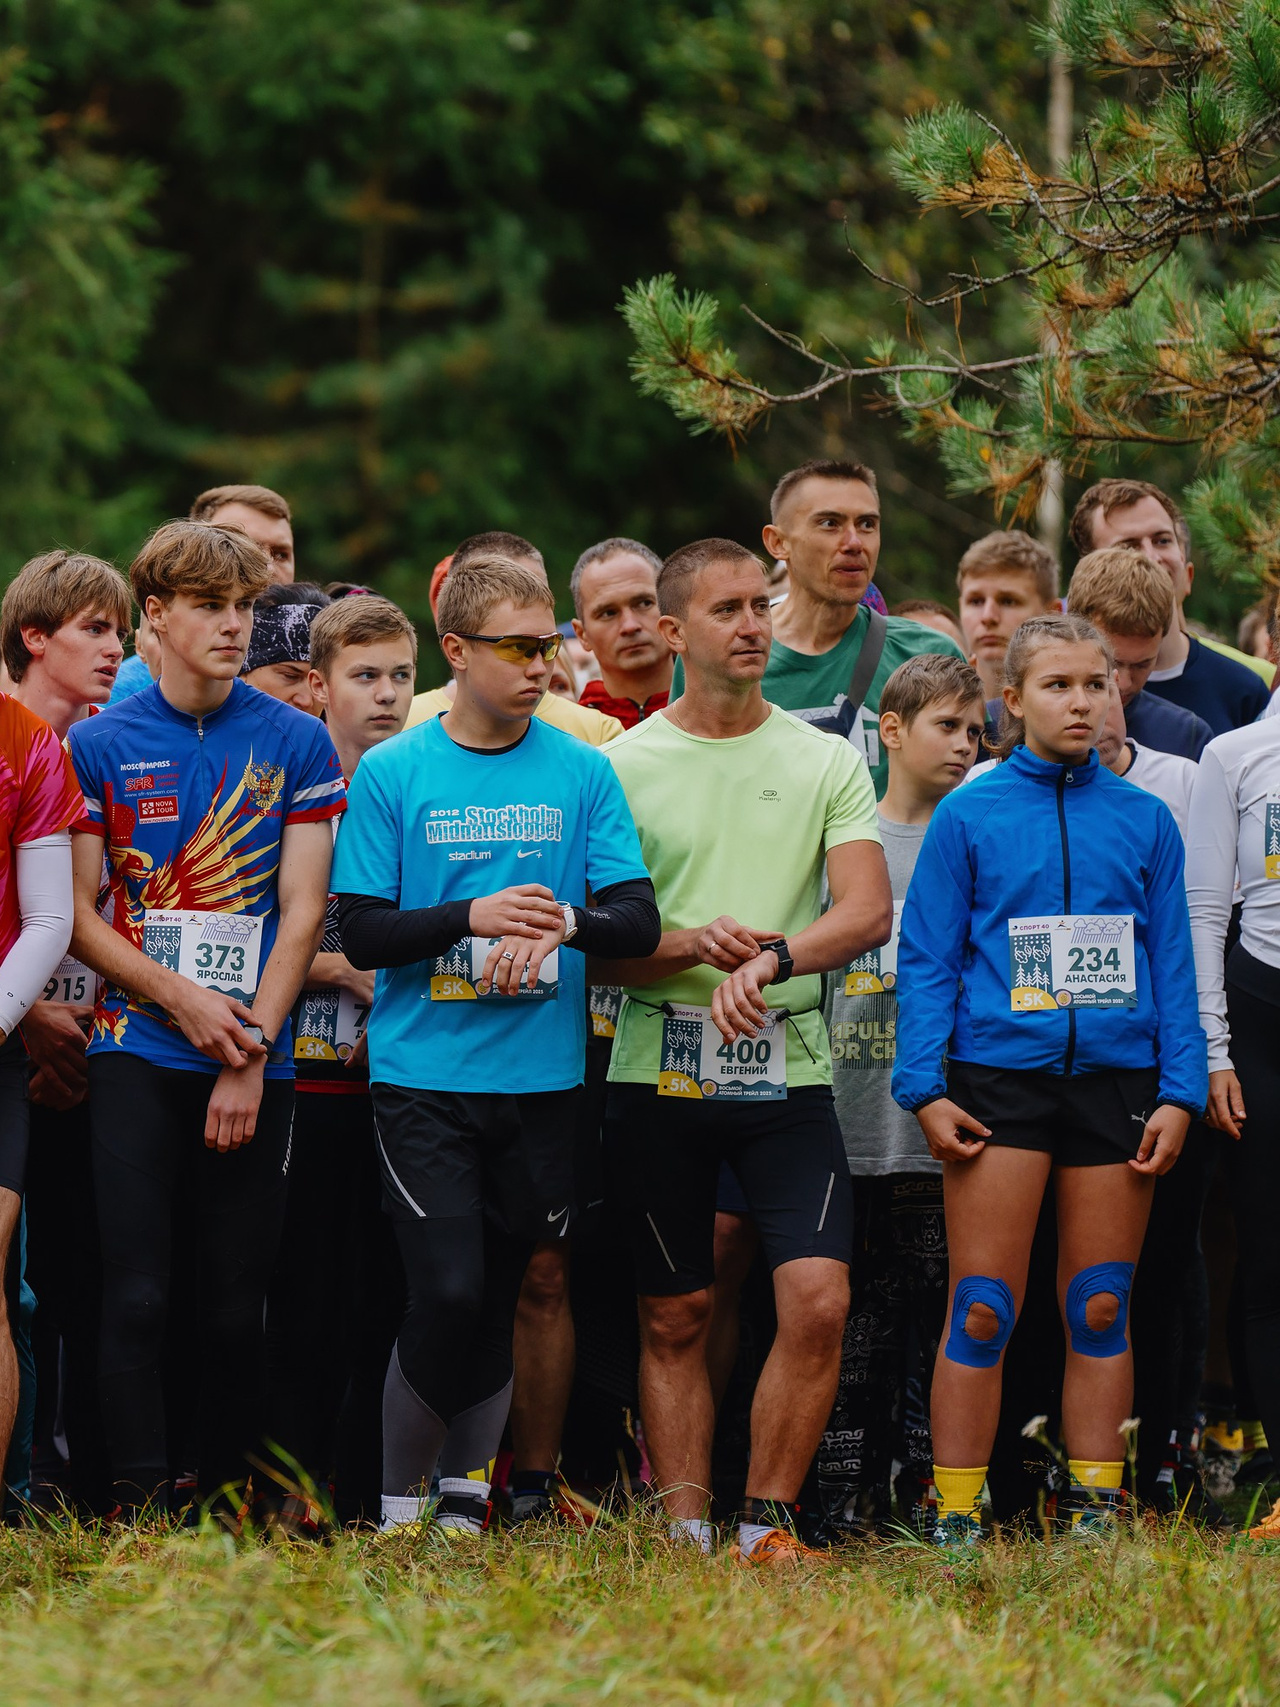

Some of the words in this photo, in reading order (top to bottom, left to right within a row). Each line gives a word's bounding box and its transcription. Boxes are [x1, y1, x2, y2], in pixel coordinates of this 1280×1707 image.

[125, 776, 153, 791] SFR
[243, 809, 282, 818] RUSSIA
[430, 809, 460, 817] 2012
[465, 804, 562, 824] Stockholm
[448, 850, 492, 861] stadium
[194, 943, 245, 971] 373
[1067, 947, 1121, 972] 234
[197, 970, 243, 983] ЯРОСЛАВ
[1064, 974, 1126, 983] АНАСТАСИЯ
[43, 976, 86, 1001] 915
[442, 981, 464, 995] 5K
[856, 976, 873, 992] 5K
[1023, 993, 1044, 1007] 5K
[305, 1043, 326, 1057] 5K
[716, 1040, 771, 1064] 400
[720, 1064, 768, 1075] ЕВГЕНИЙ
[670, 1078, 690, 1093] 5K
